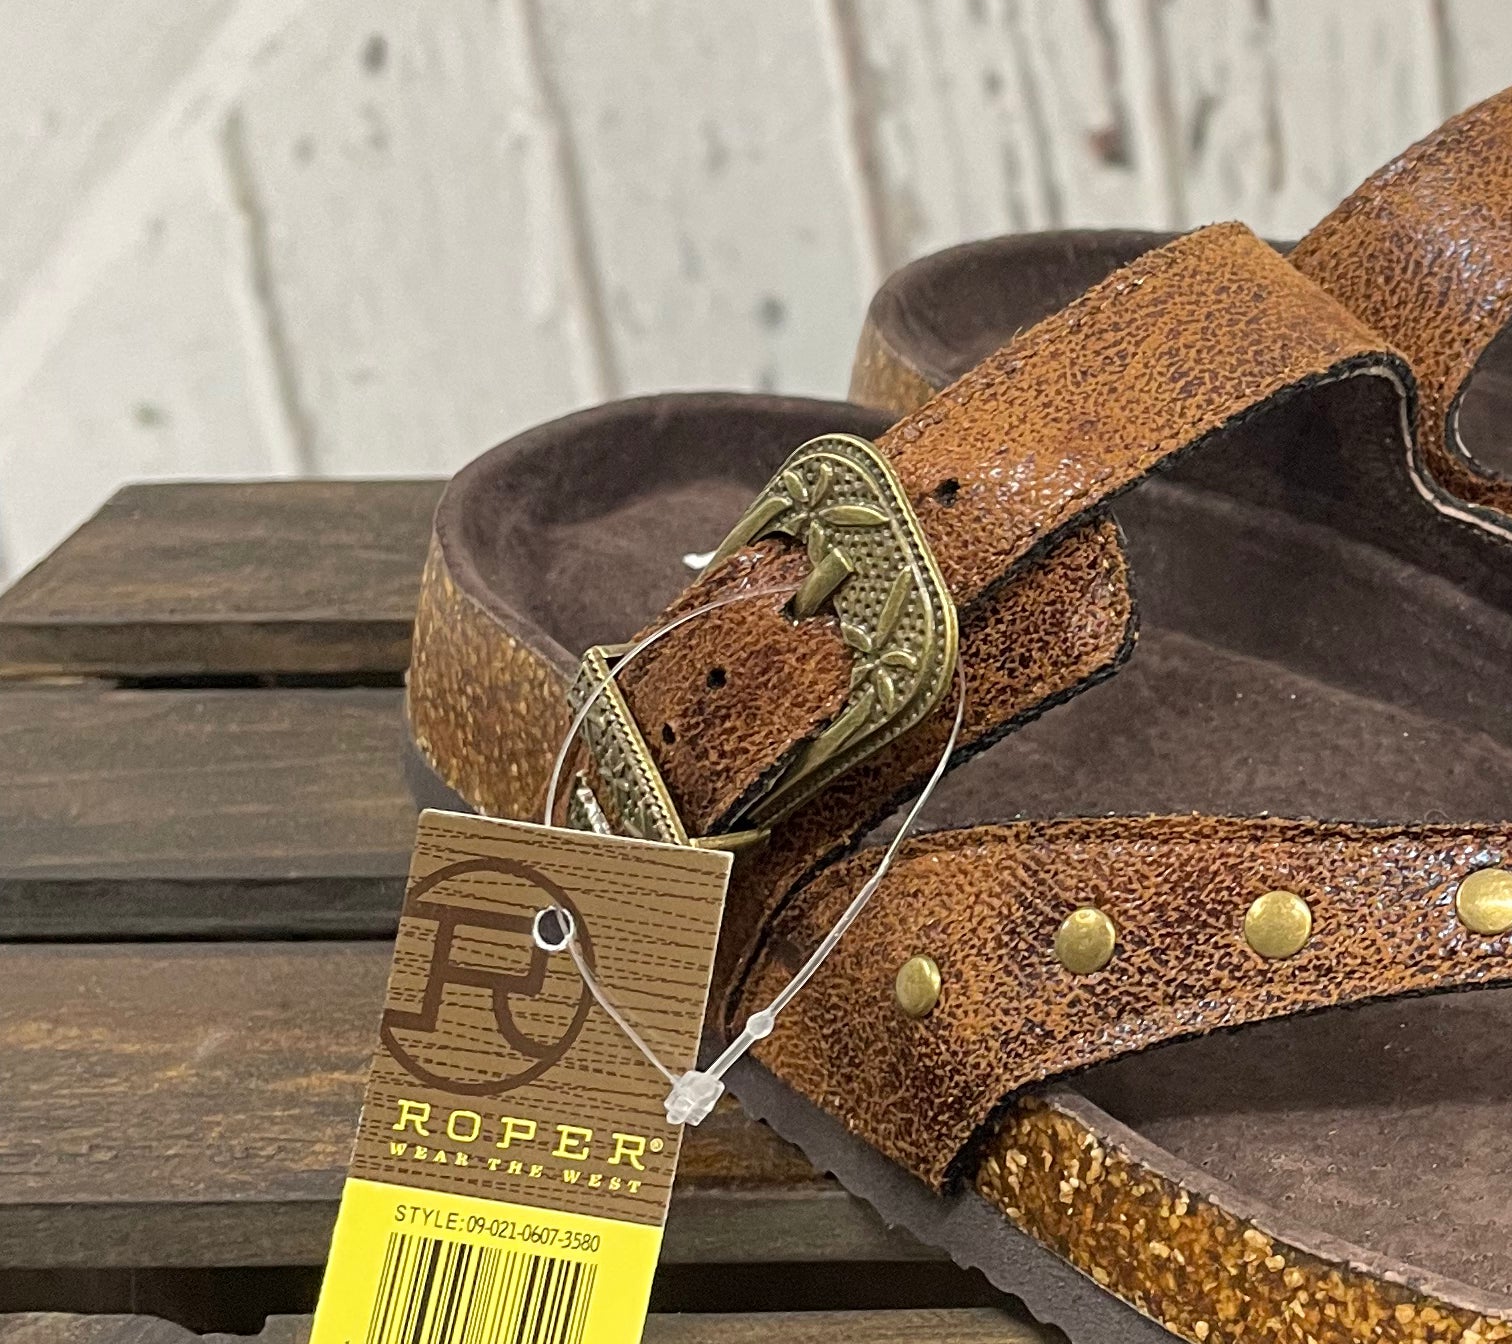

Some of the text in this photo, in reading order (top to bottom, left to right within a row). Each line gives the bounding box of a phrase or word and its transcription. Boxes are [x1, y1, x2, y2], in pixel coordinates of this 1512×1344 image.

[389, 1141, 641, 1193] WEAR THE WEST
